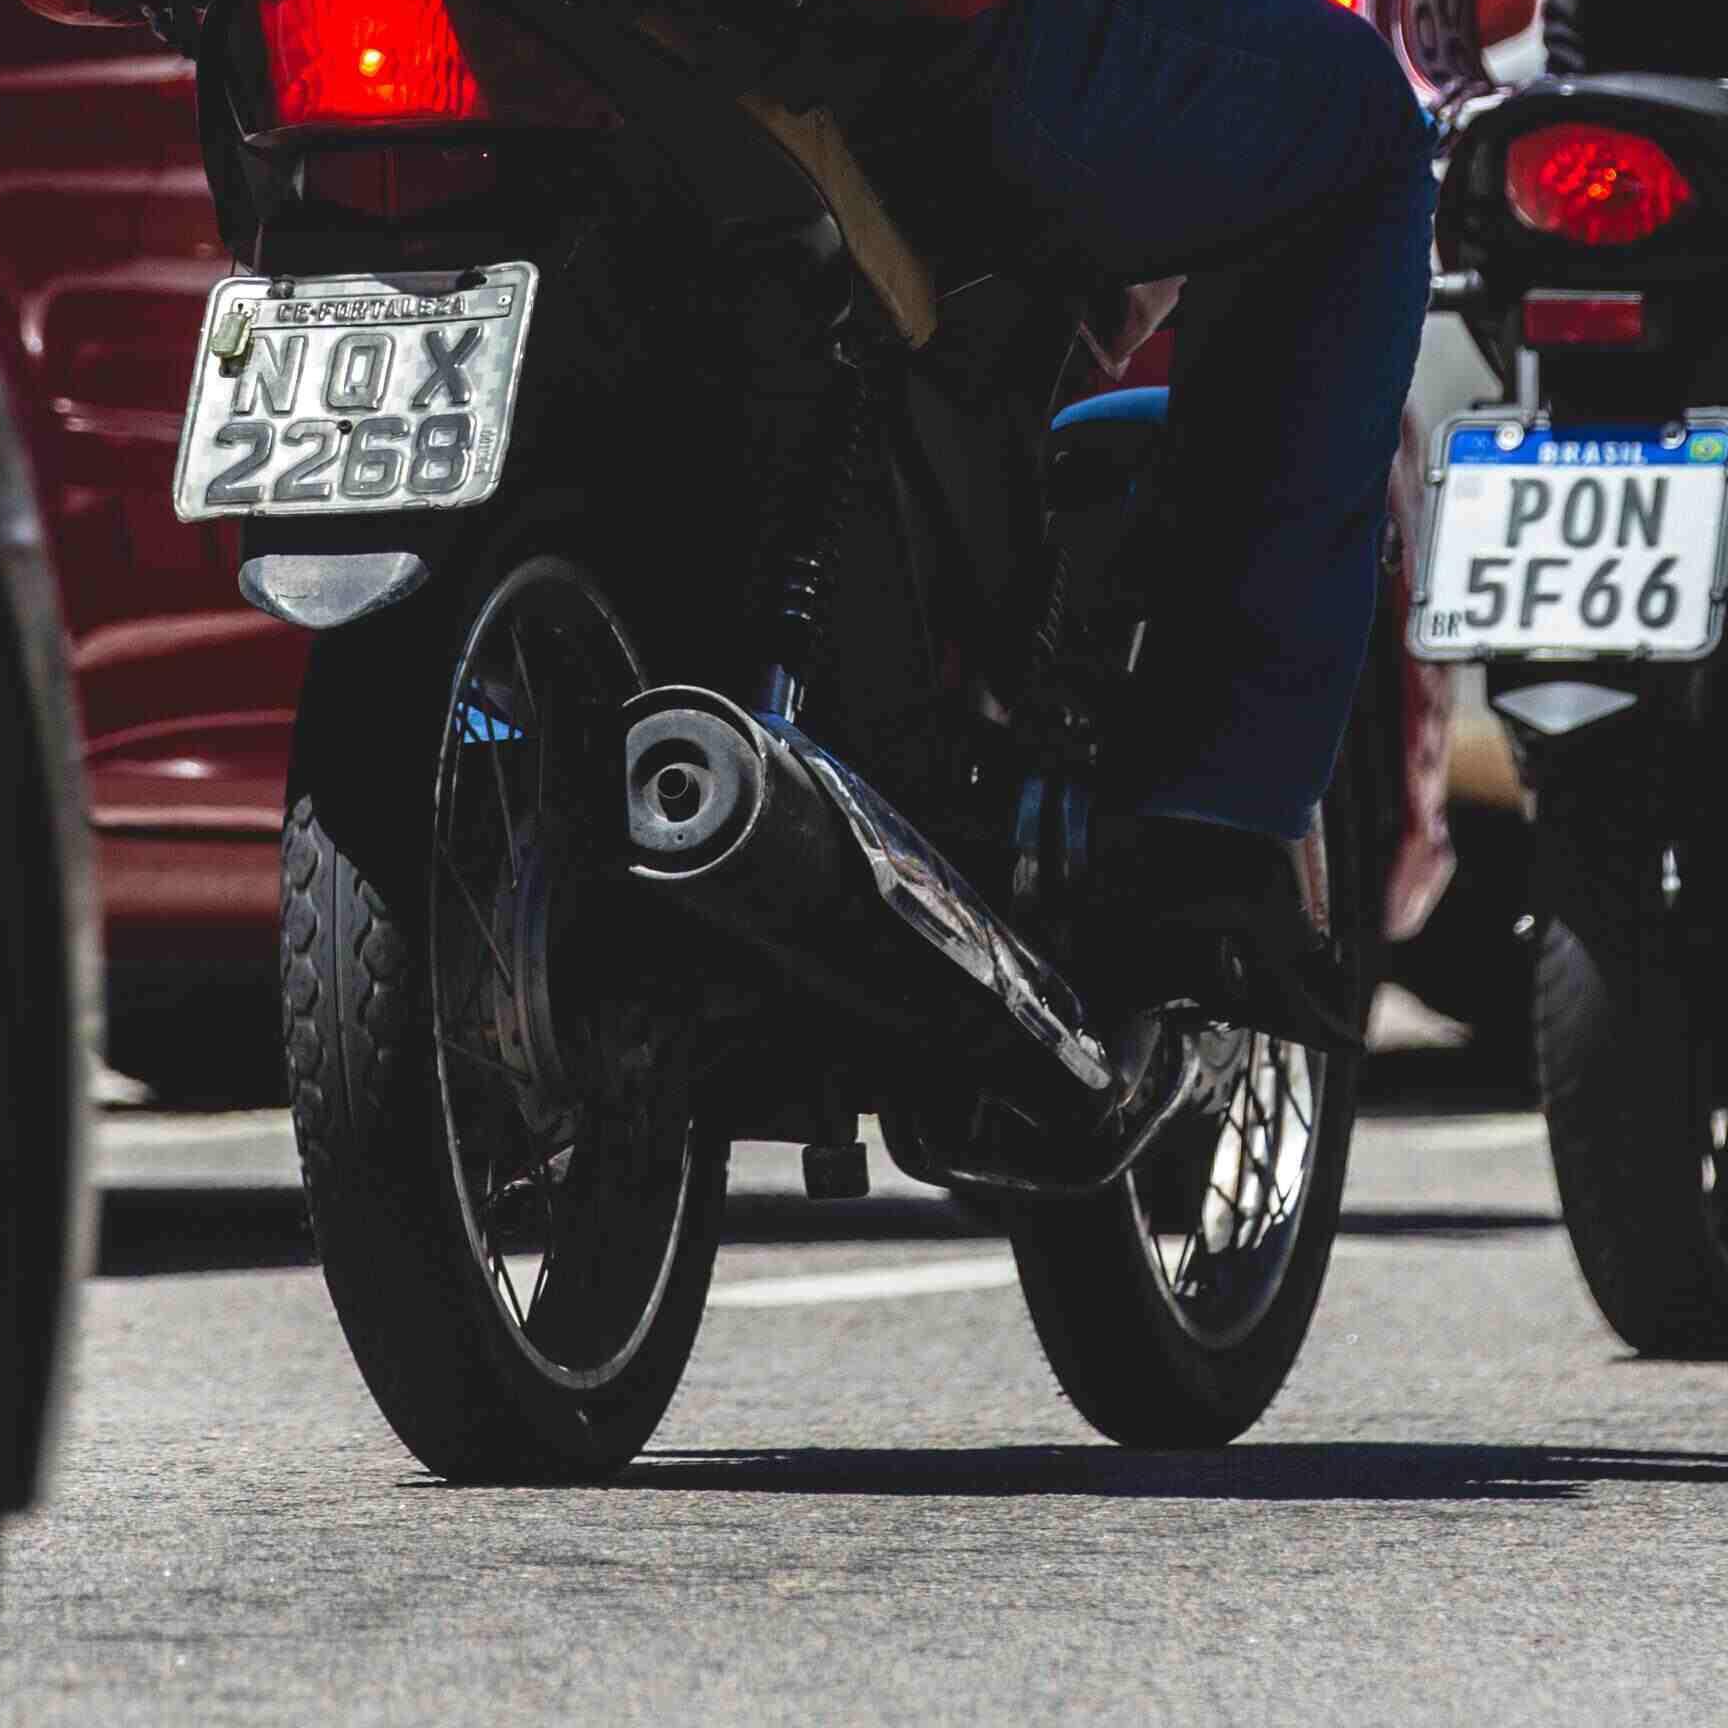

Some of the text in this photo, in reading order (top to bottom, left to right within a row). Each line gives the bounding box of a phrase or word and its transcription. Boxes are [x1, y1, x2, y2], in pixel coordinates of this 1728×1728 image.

[205, 412, 477, 506] 2268
[1537, 441, 1648, 465] BRASIL
[1464, 556, 1681, 630] 5F66
[1431, 612, 1463, 638] BR
